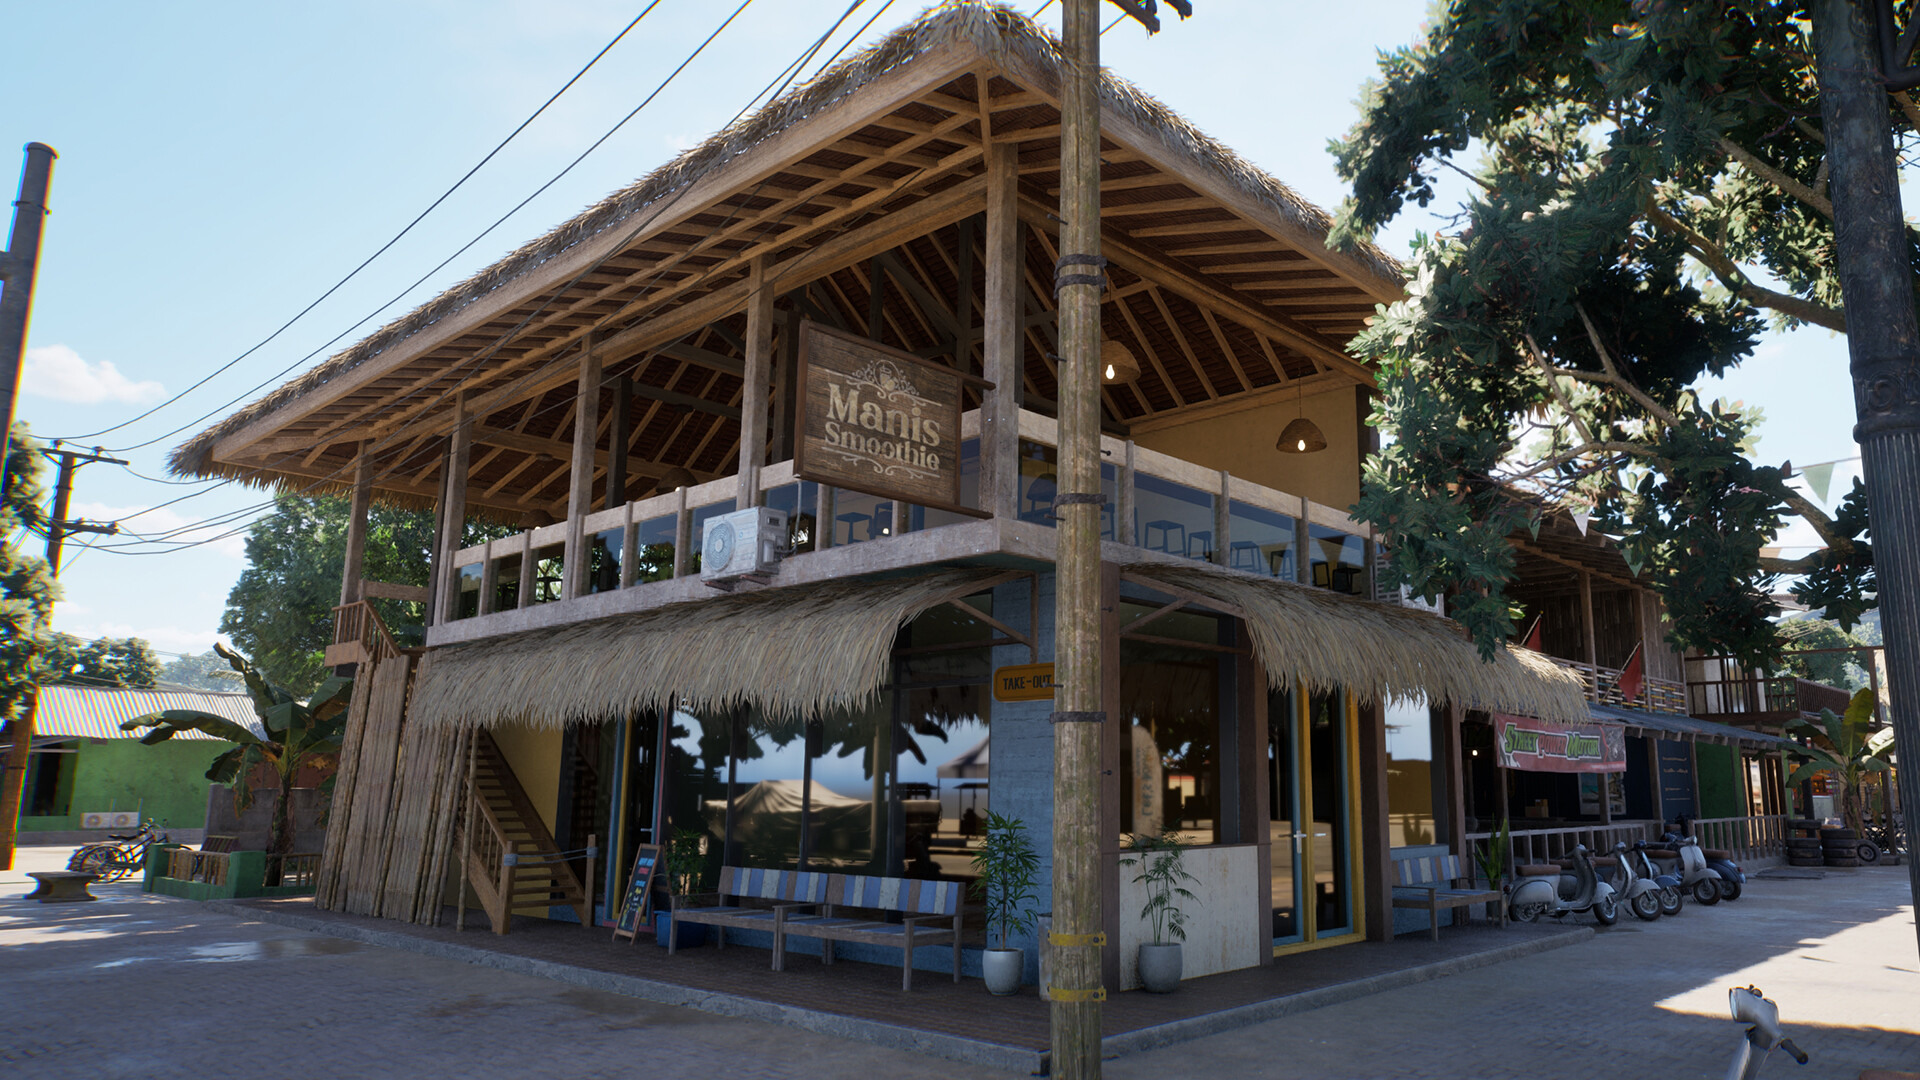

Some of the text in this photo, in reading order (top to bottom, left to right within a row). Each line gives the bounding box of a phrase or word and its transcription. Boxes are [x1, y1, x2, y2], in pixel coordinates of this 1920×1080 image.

[826, 382, 940, 447] Manis
[825, 421, 940, 471] Smoothie
[1002, 674, 1052, 690] TAKE-OUT
[1505, 724, 1600, 758] STREET POWER MOTOR
